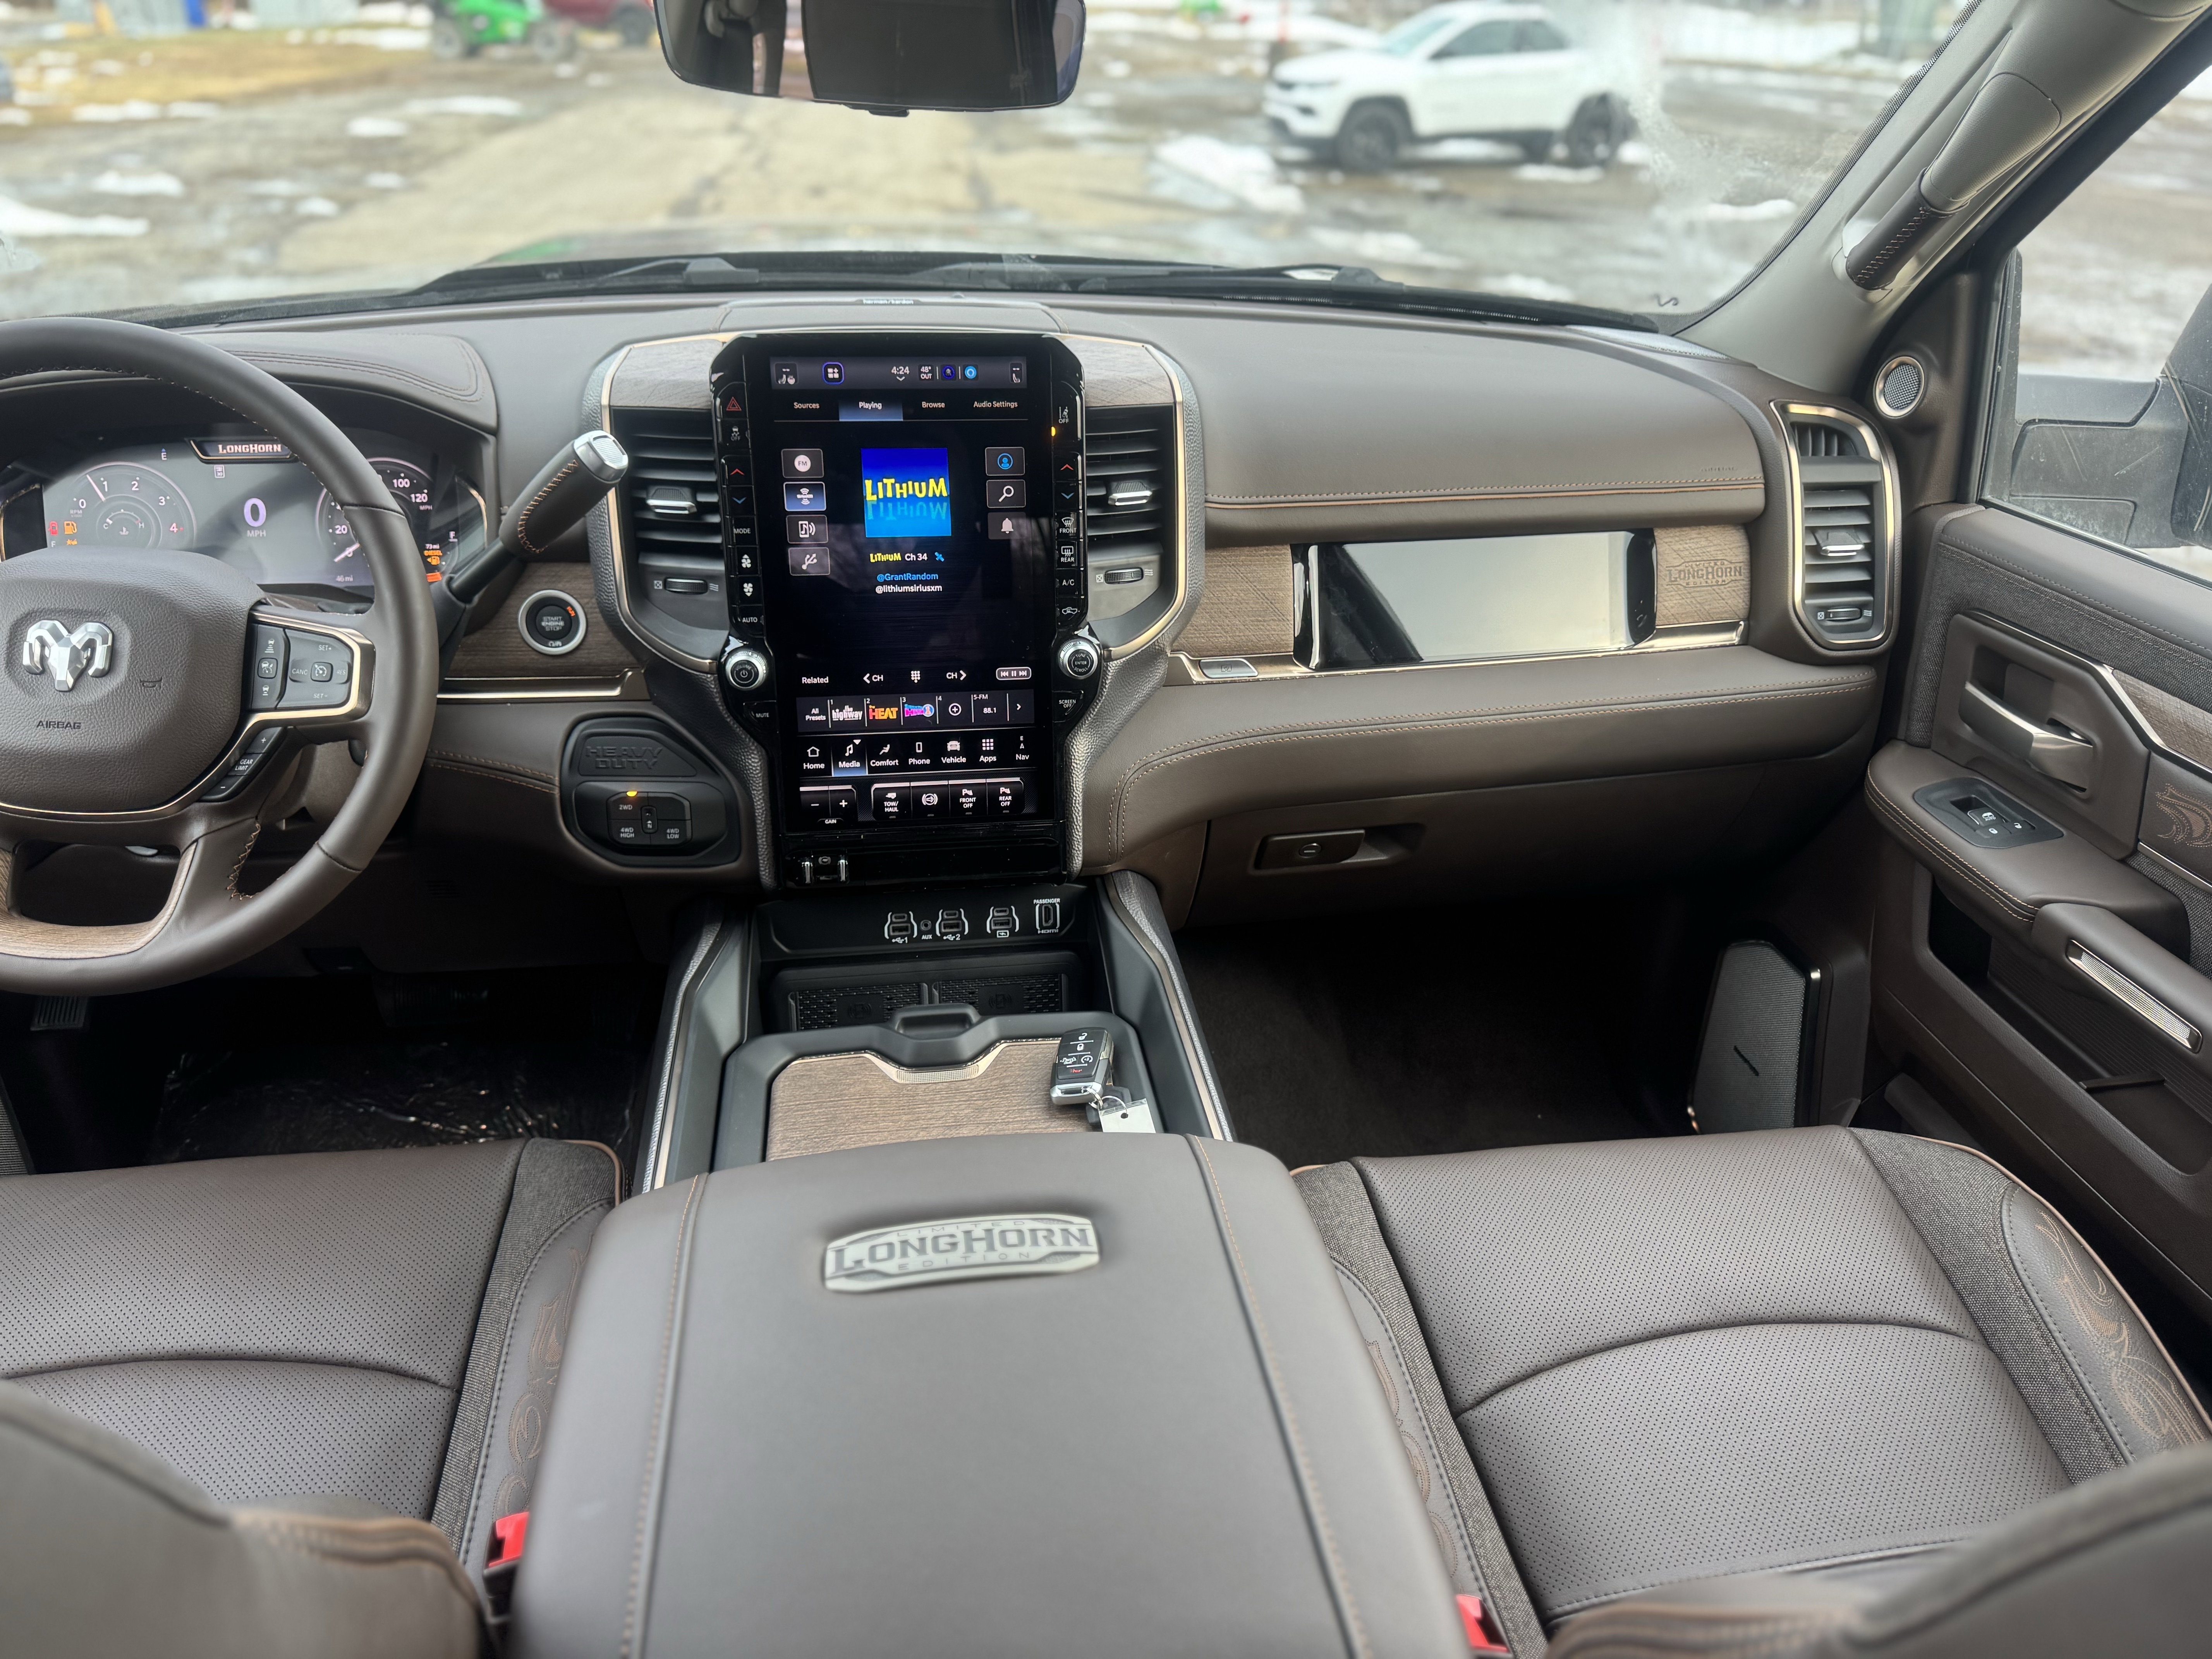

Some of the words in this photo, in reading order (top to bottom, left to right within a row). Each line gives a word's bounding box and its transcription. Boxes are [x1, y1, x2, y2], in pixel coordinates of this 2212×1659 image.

[891, 366, 910, 375] 4:24
[859, 402, 882, 410] Playing
[993, 400, 1018, 409] Settings
[161, 452, 167, 460] E
[103, 481, 108, 492] 1
[132, 481, 139, 491] 2
[393, 479, 410, 488] 100
[159, 496, 166, 506] 3
[410, 493, 428, 503] 120
[79, 499, 86, 508] 0
[244, 498, 266, 527] 0
[170, 523, 178, 533] 4
[335, 525, 348, 534] 20
[905, 553, 916, 561] Ch
[917, 553, 928, 561] 34
[877, 572, 938, 582] @GrantRandom
[875, 584, 943, 594] @lithiumsiriusxm
[832, 709, 863, 721] highway
[869, 708, 898, 720] HEAT
[36, 720, 82, 730] AIRBAG
[585, 746, 663, 758] HEAVY
[595, 758, 658, 769] DUTY
[870, 759, 899, 767] Comfort
[896, 1221, 1025, 1237] LIMITED
[898, 1251, 1029, 1271] EDITION
